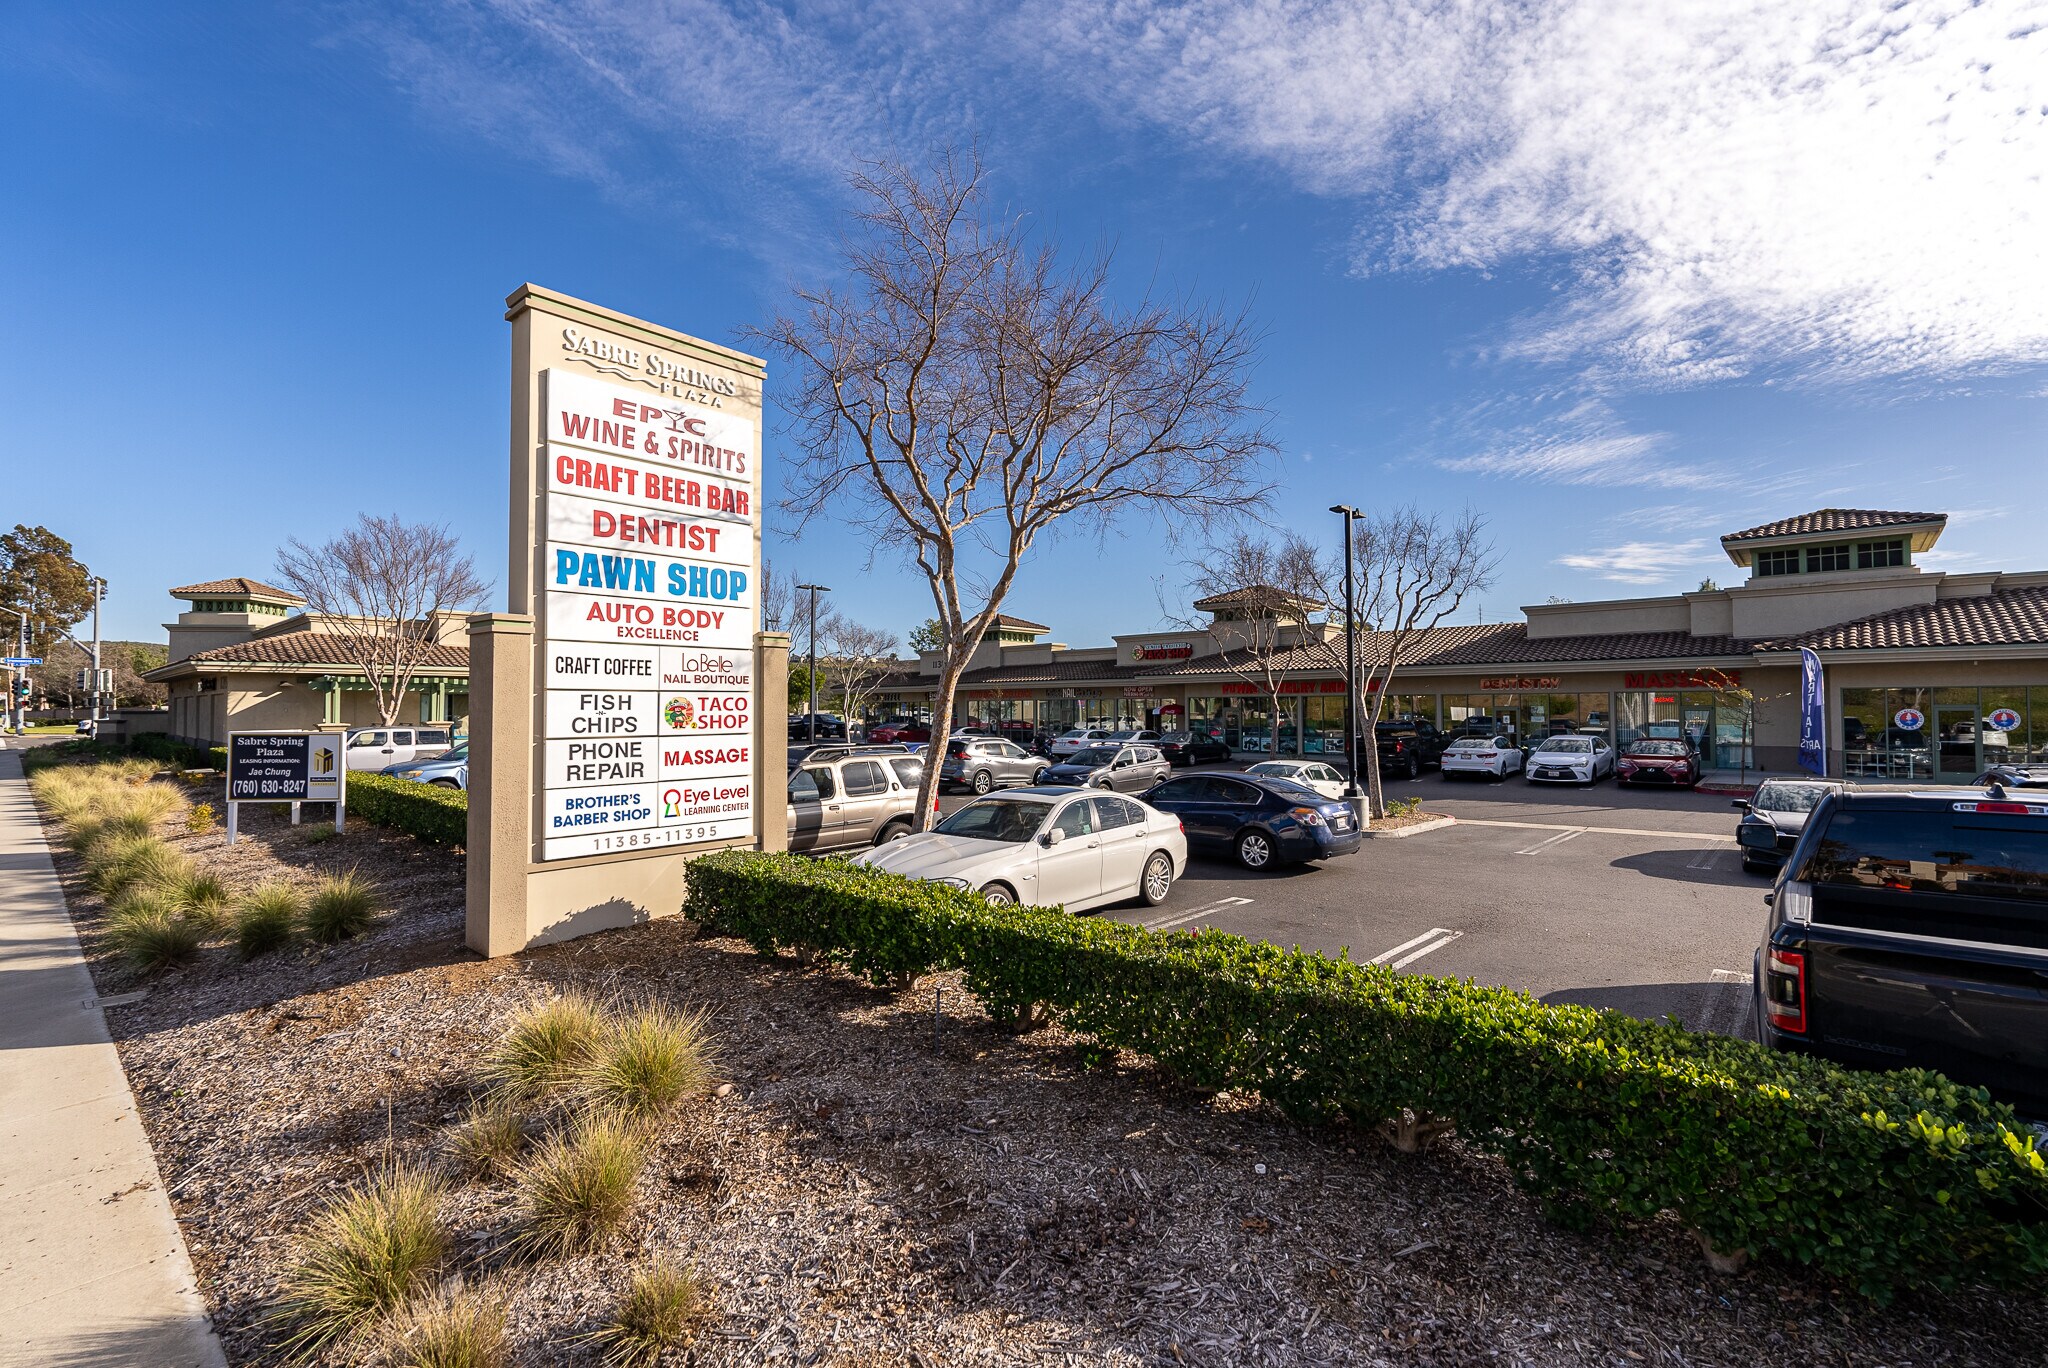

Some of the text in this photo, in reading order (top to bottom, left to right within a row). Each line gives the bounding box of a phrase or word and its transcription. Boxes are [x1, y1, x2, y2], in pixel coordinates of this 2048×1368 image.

[562, 327, 737, 397] SABRE SPRINGS
[661, 382, 724, 408] PLAZA
[561, 410, 746, 474] WINE & SPIRITS
[556, 455, 749, 516] CRAFT BEER BAR
[593, 509, 720, 553] DENTIST
[556, 548, 748, 601] PAWN SHOP
[586, 601, 725, 630] AUTO BODY
[617, 626, 699, 642] EXCELLENCE
[1168, 648, 1193, 659] SHOP
[555, 656, 652, 676] CRAFT COFFEE
[682, 653, 734, 673] LaBelle
[663, 674, 750, 686] NAIL BOUTIQUE
[1320, 682, 1346, 693] AND
[1480, 677, 1560, 691] DENTISTRY
[1624, 671, 1743, 689] MASSAGE
[1063, 688, 1076, 698] NAIL
[580, 694, 632, 711] FISH
[698, 697, 748, 711] TACO
[571, 717, 638, 734] CHIPS
[698, 715, 749, 729] SHOP
[237, 737, 305, 747] Sabre Spring
[256, 748, 284, 756] Plaza
[568, 742, 642, 761] PHONE
[664, 748, 749, 767] MASSAGE
[248, 767, 292, 777] Jae Chung
[567, 762, 644, 781] REPAIR
[233, 780, 306, 797] (760) 630-8247
[684, 785, 749, 804] Eye Level
[565, 793, 641, 811] BROTHER'S
[684, 802, 749, 816] LEARNING CENTER
[554, 808, 651, 828] BARBER SHOP
